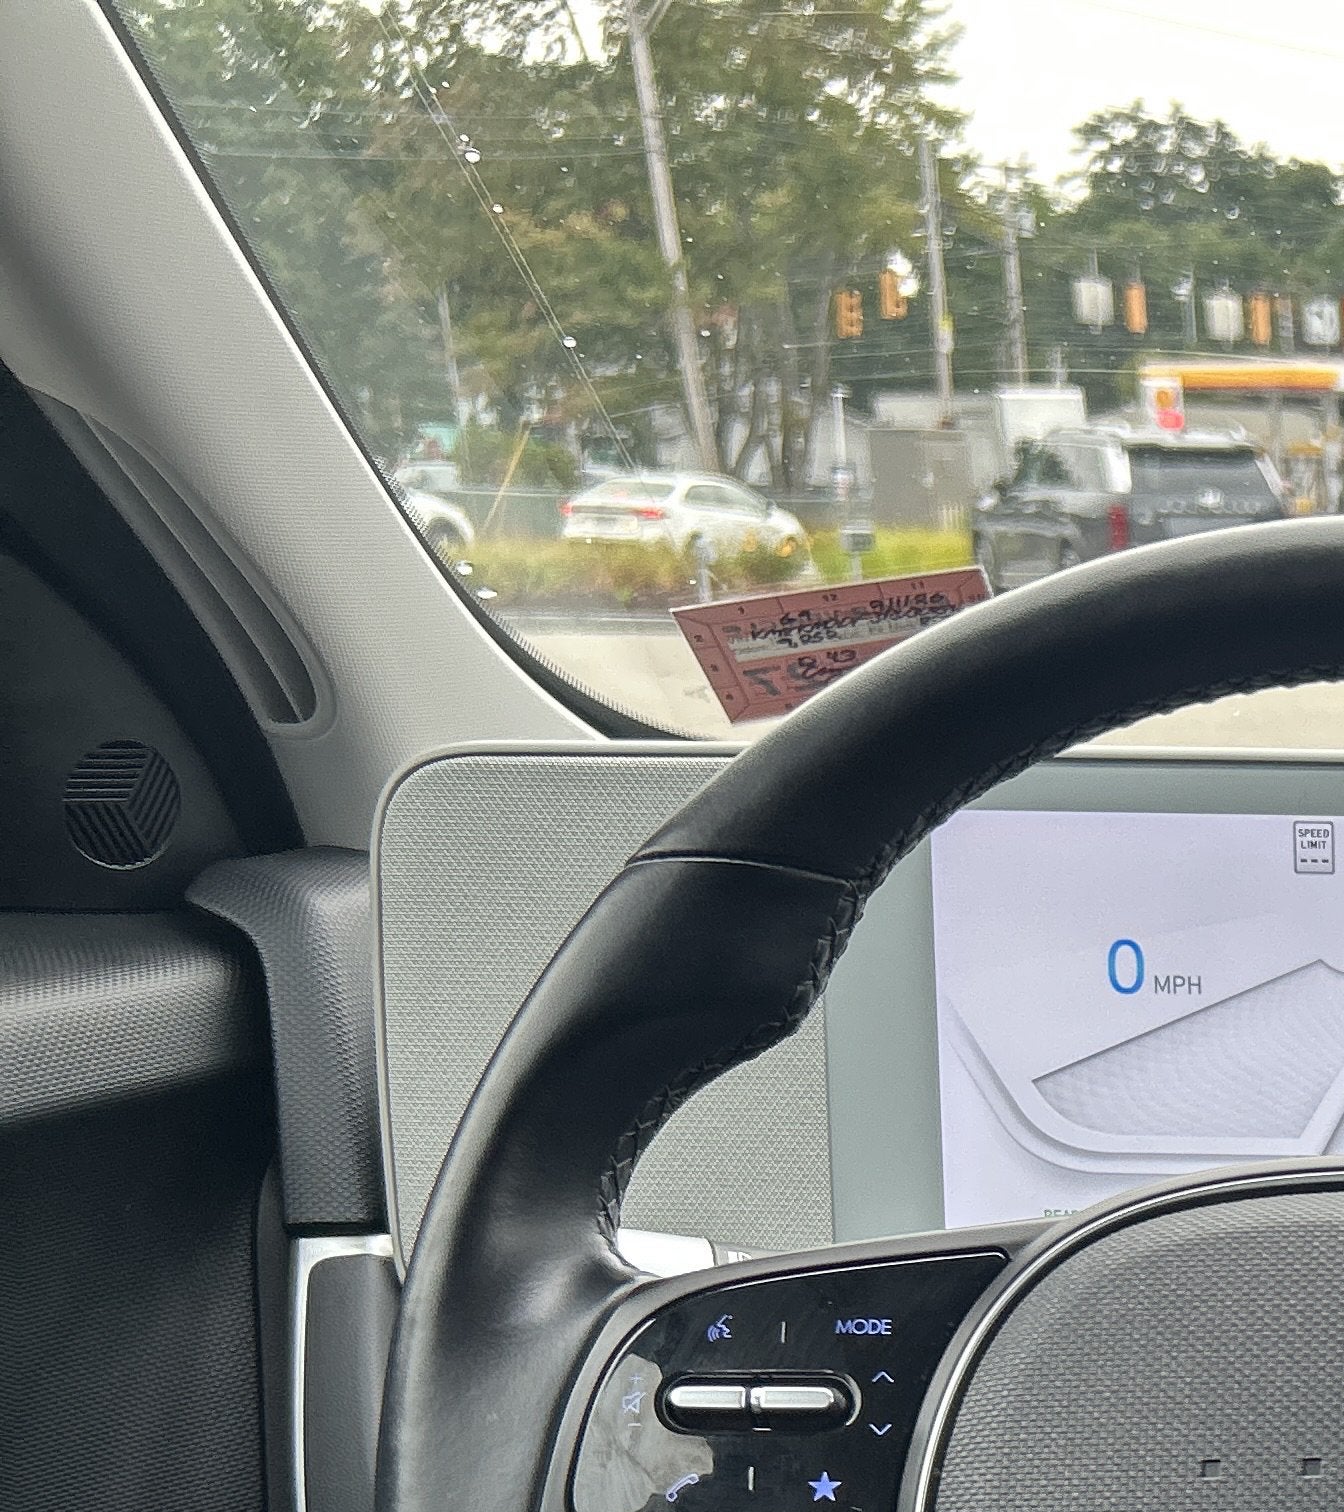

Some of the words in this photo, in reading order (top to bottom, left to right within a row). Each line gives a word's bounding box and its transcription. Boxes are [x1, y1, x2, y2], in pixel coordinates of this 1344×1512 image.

[1298, 828, 1331, 839] SPEED
[1300, 840, 1327, 851] LIMIT
[1107, 939, 1145, 995] 0
[1153, 975, 1202, 996] MPH
[836, 1318, 893, 1335] MODE
